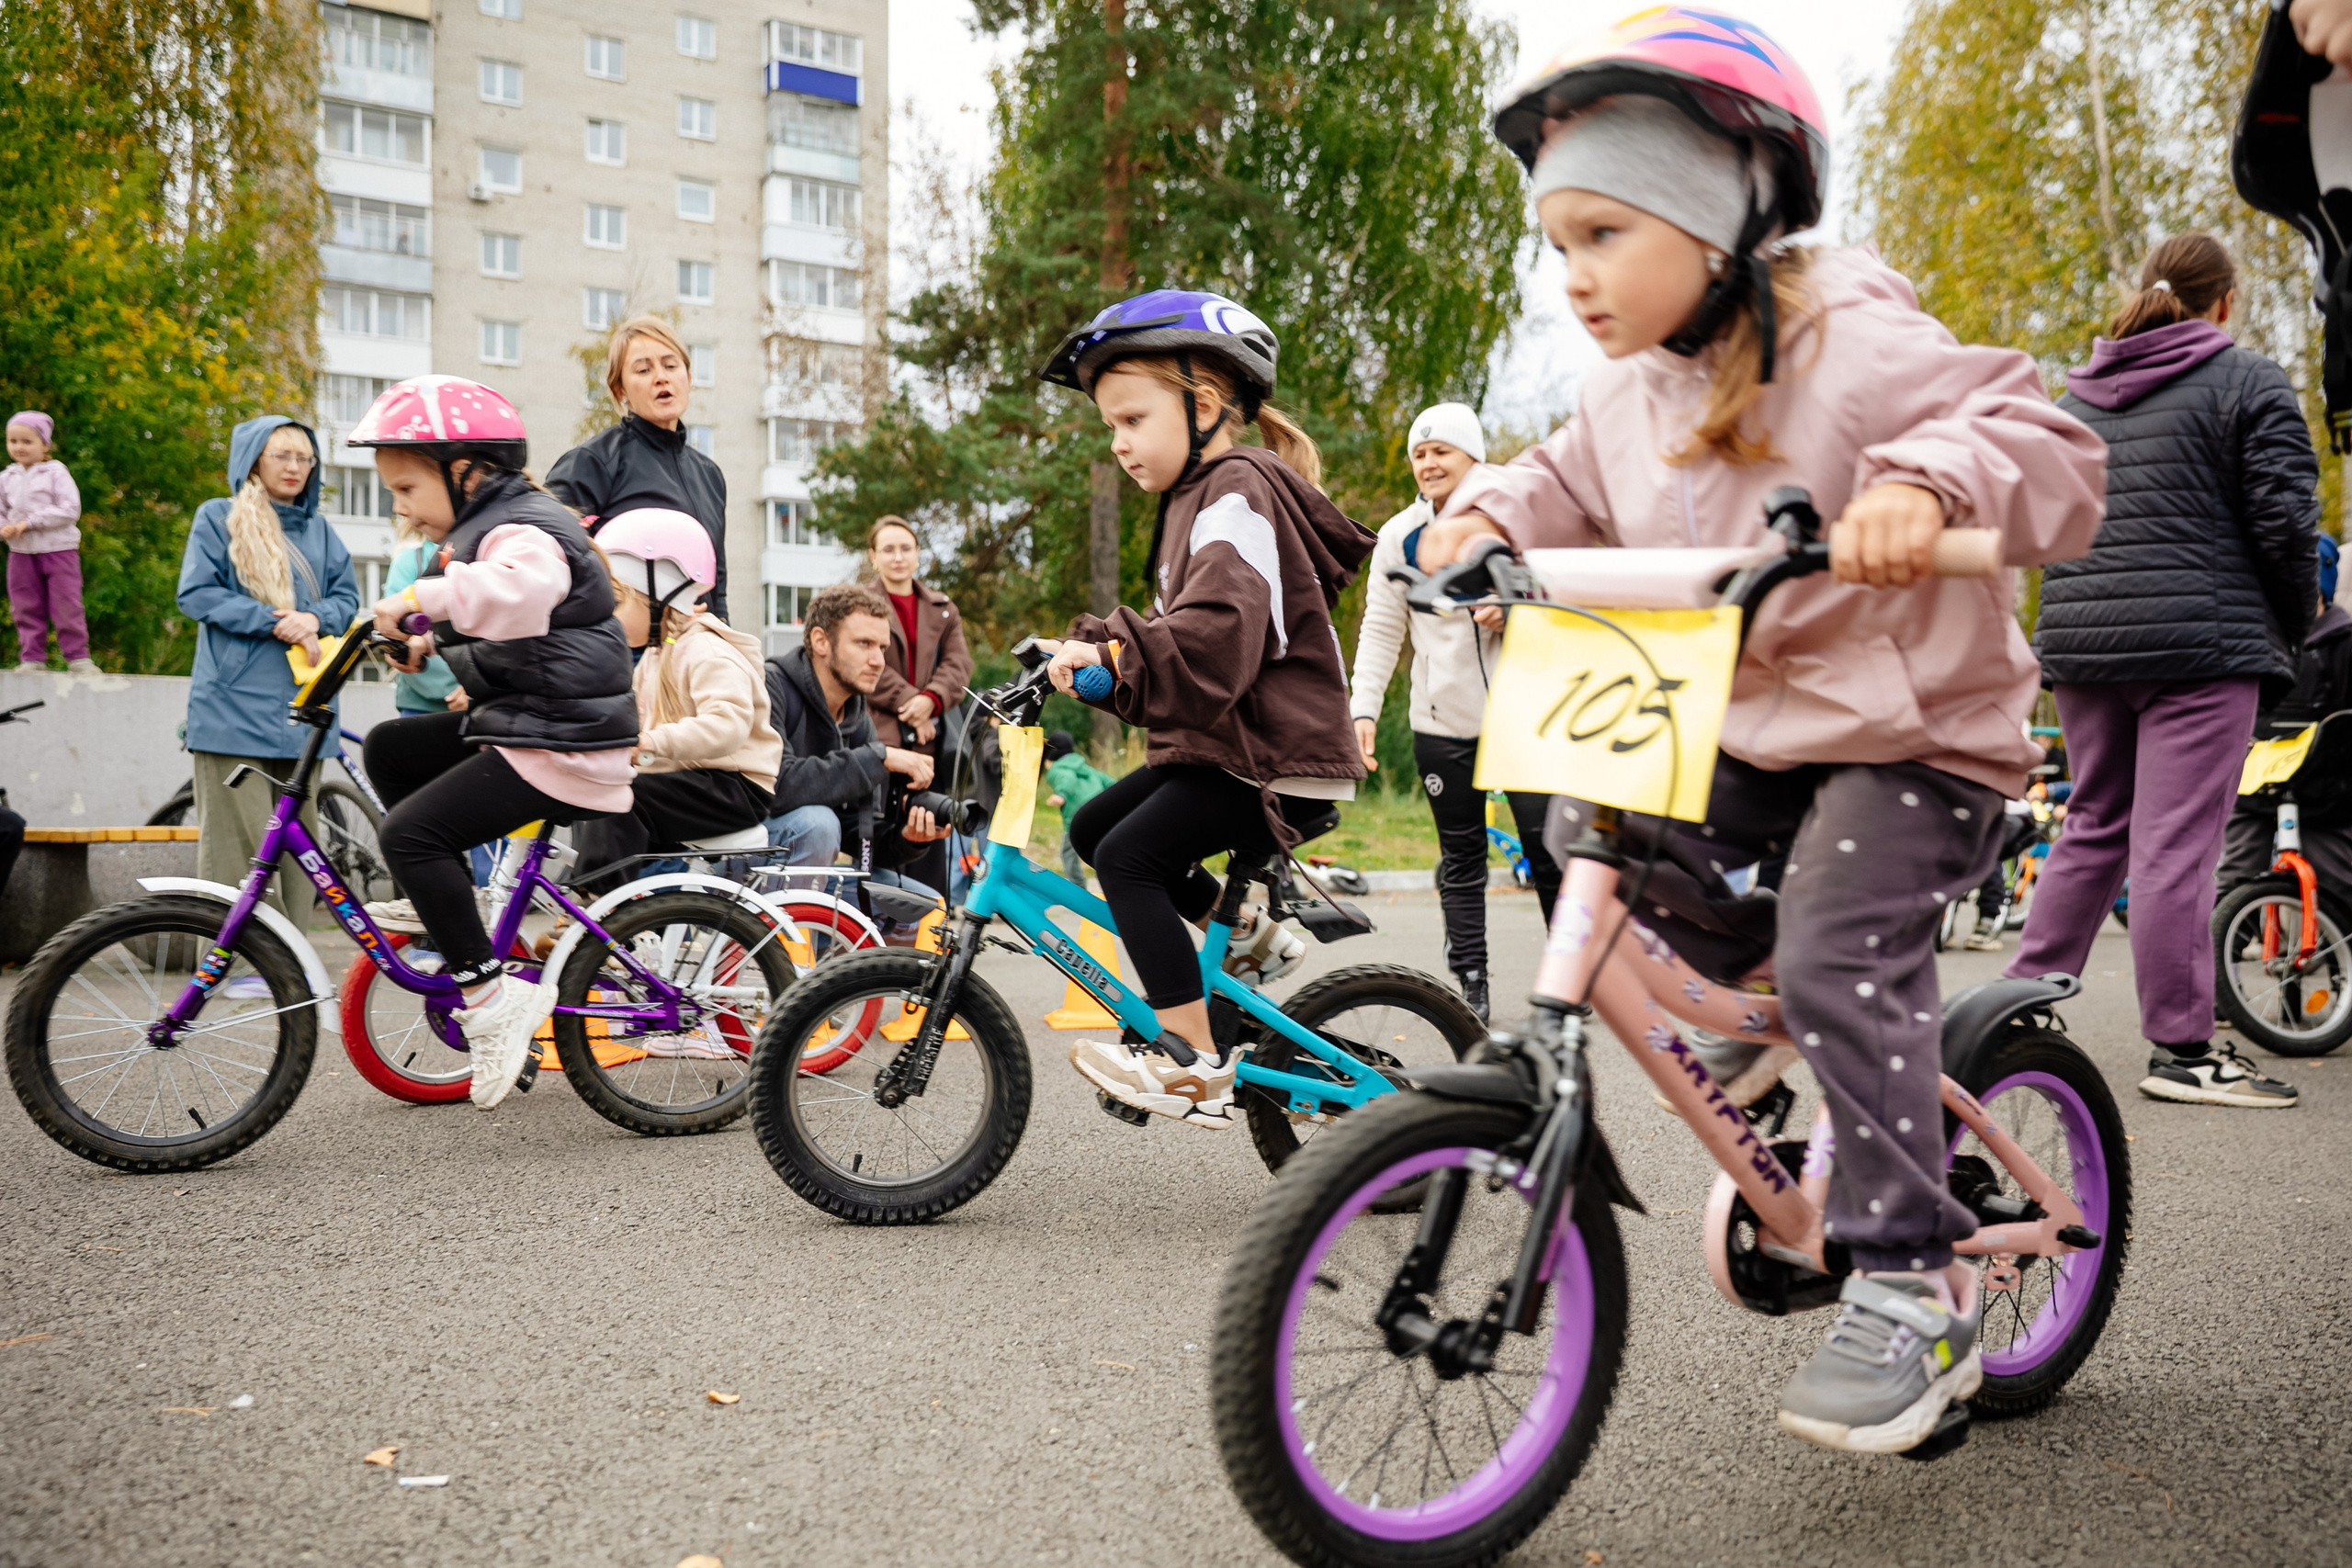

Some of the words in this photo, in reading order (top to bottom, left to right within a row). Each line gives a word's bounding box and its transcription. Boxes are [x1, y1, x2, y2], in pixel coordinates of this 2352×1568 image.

[1536, 670, 1688, 753] 105
[861, 838, 871, 873] SONY
[1056, 938, 1108, 991] Capella
